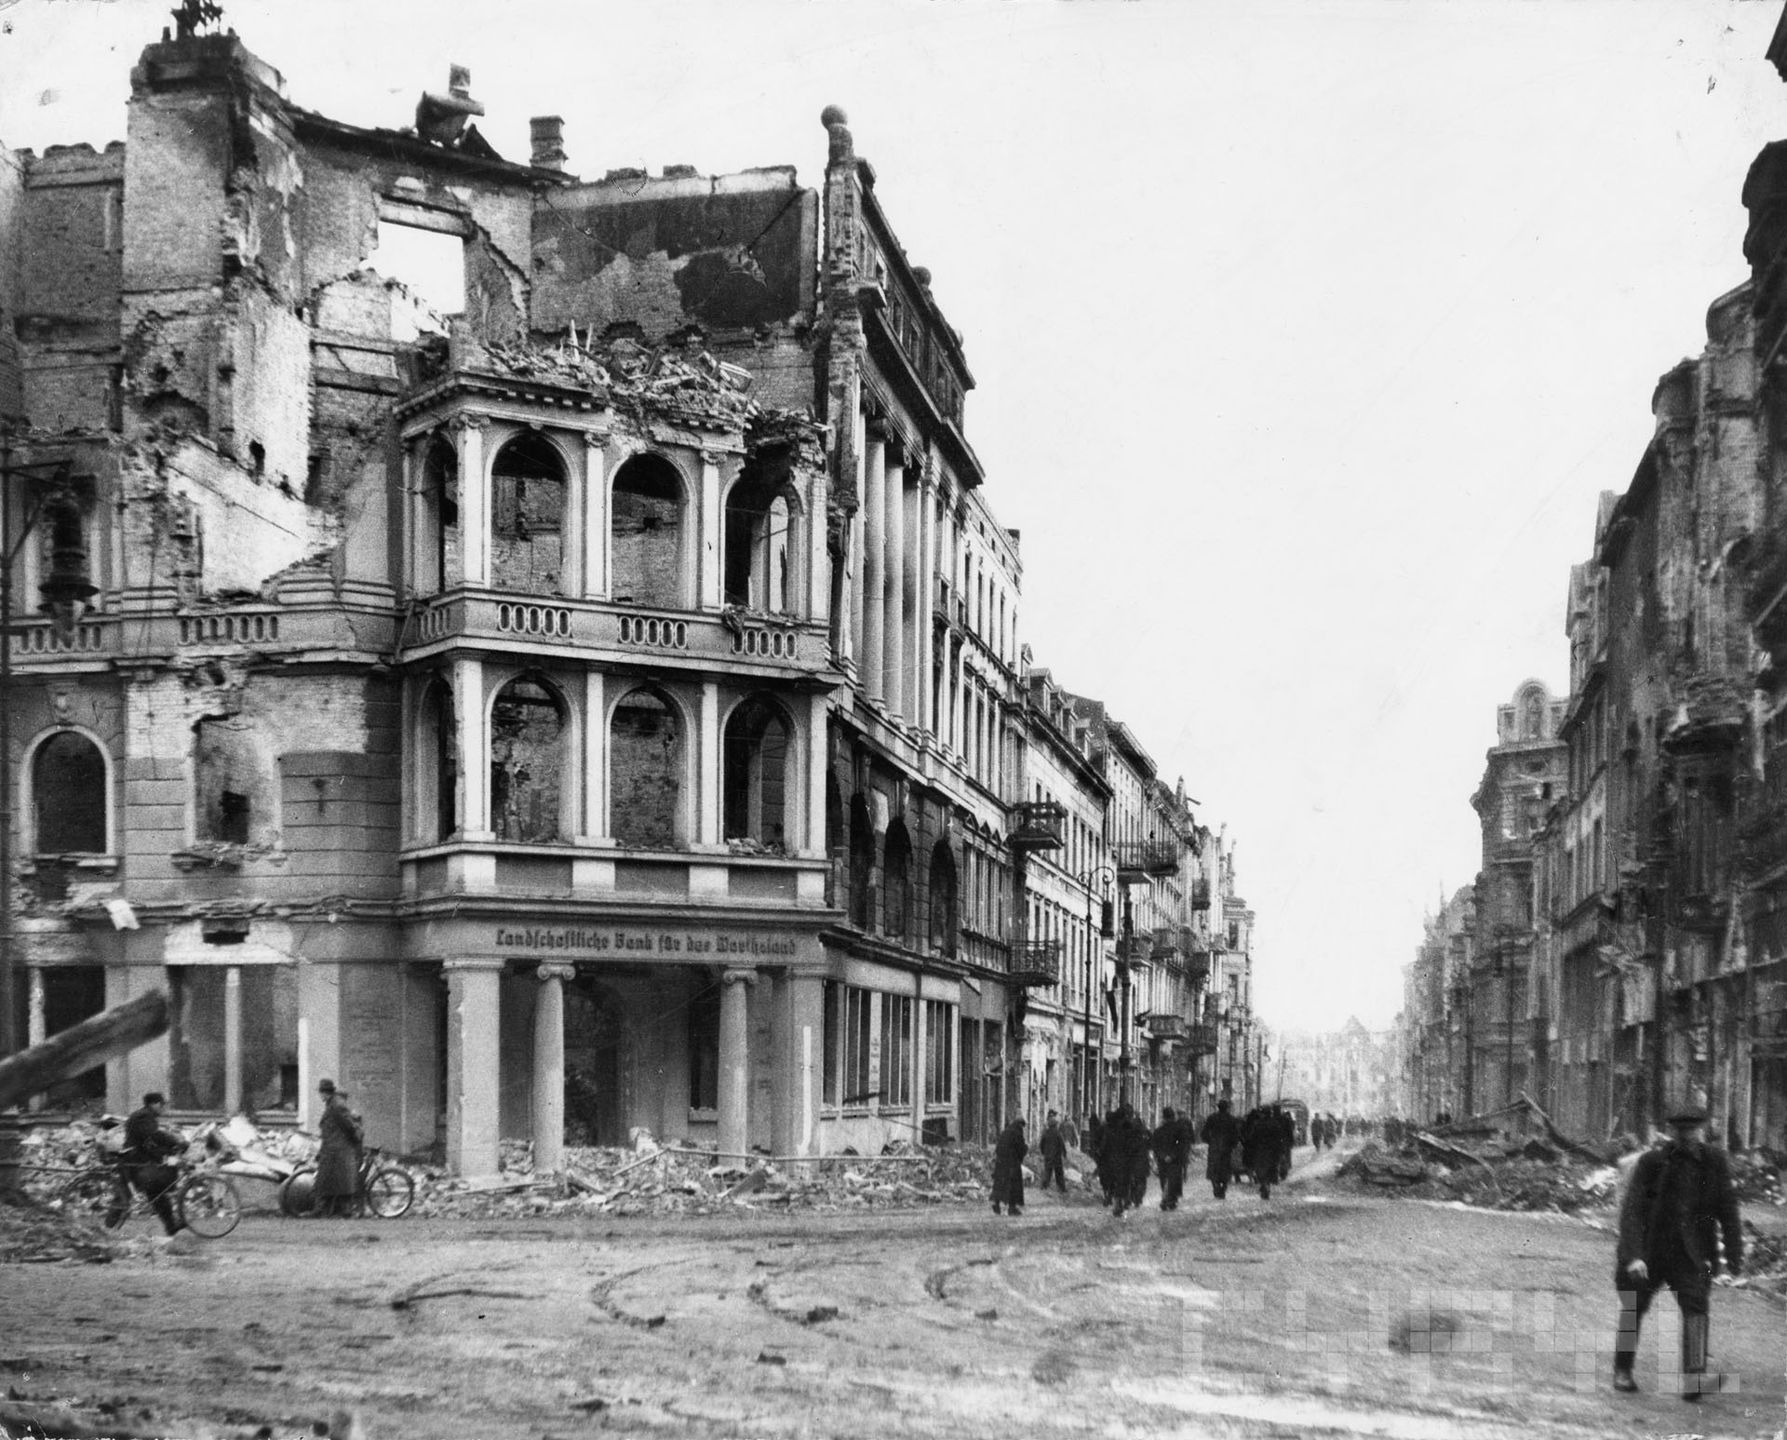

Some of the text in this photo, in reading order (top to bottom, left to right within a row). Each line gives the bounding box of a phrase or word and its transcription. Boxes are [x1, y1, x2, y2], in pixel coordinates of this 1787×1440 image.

[615, 932, 653, 951] Bank
[658, 934, 680, 954] für
[687, 935, 710, 953] das
[717, 935, 796, 956] Wartheland
